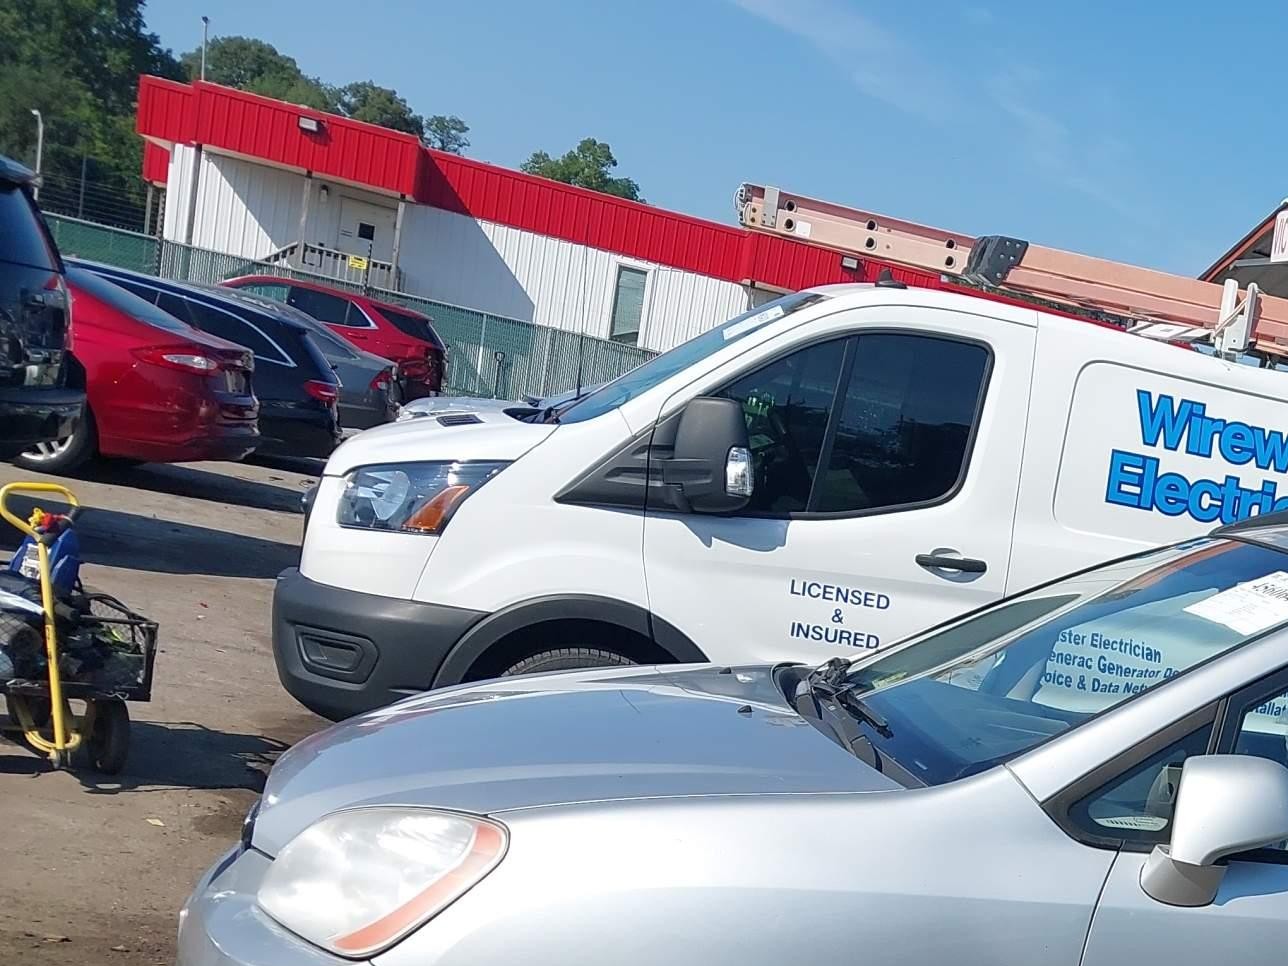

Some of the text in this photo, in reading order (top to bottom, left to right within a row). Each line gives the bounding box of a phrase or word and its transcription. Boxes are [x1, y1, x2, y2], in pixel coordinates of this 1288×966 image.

[790, 579, 890, 609] LICENSED
[831, 608, 844, 624] &
[790, 622, 880, 649] INSURED
[1057, 630, 1162, 663] ster Electrician
[1098, 656, 1160, 679] Generator
[1077, 675, 1087, 691] &
[1092, 678, 1119, 694] Data
